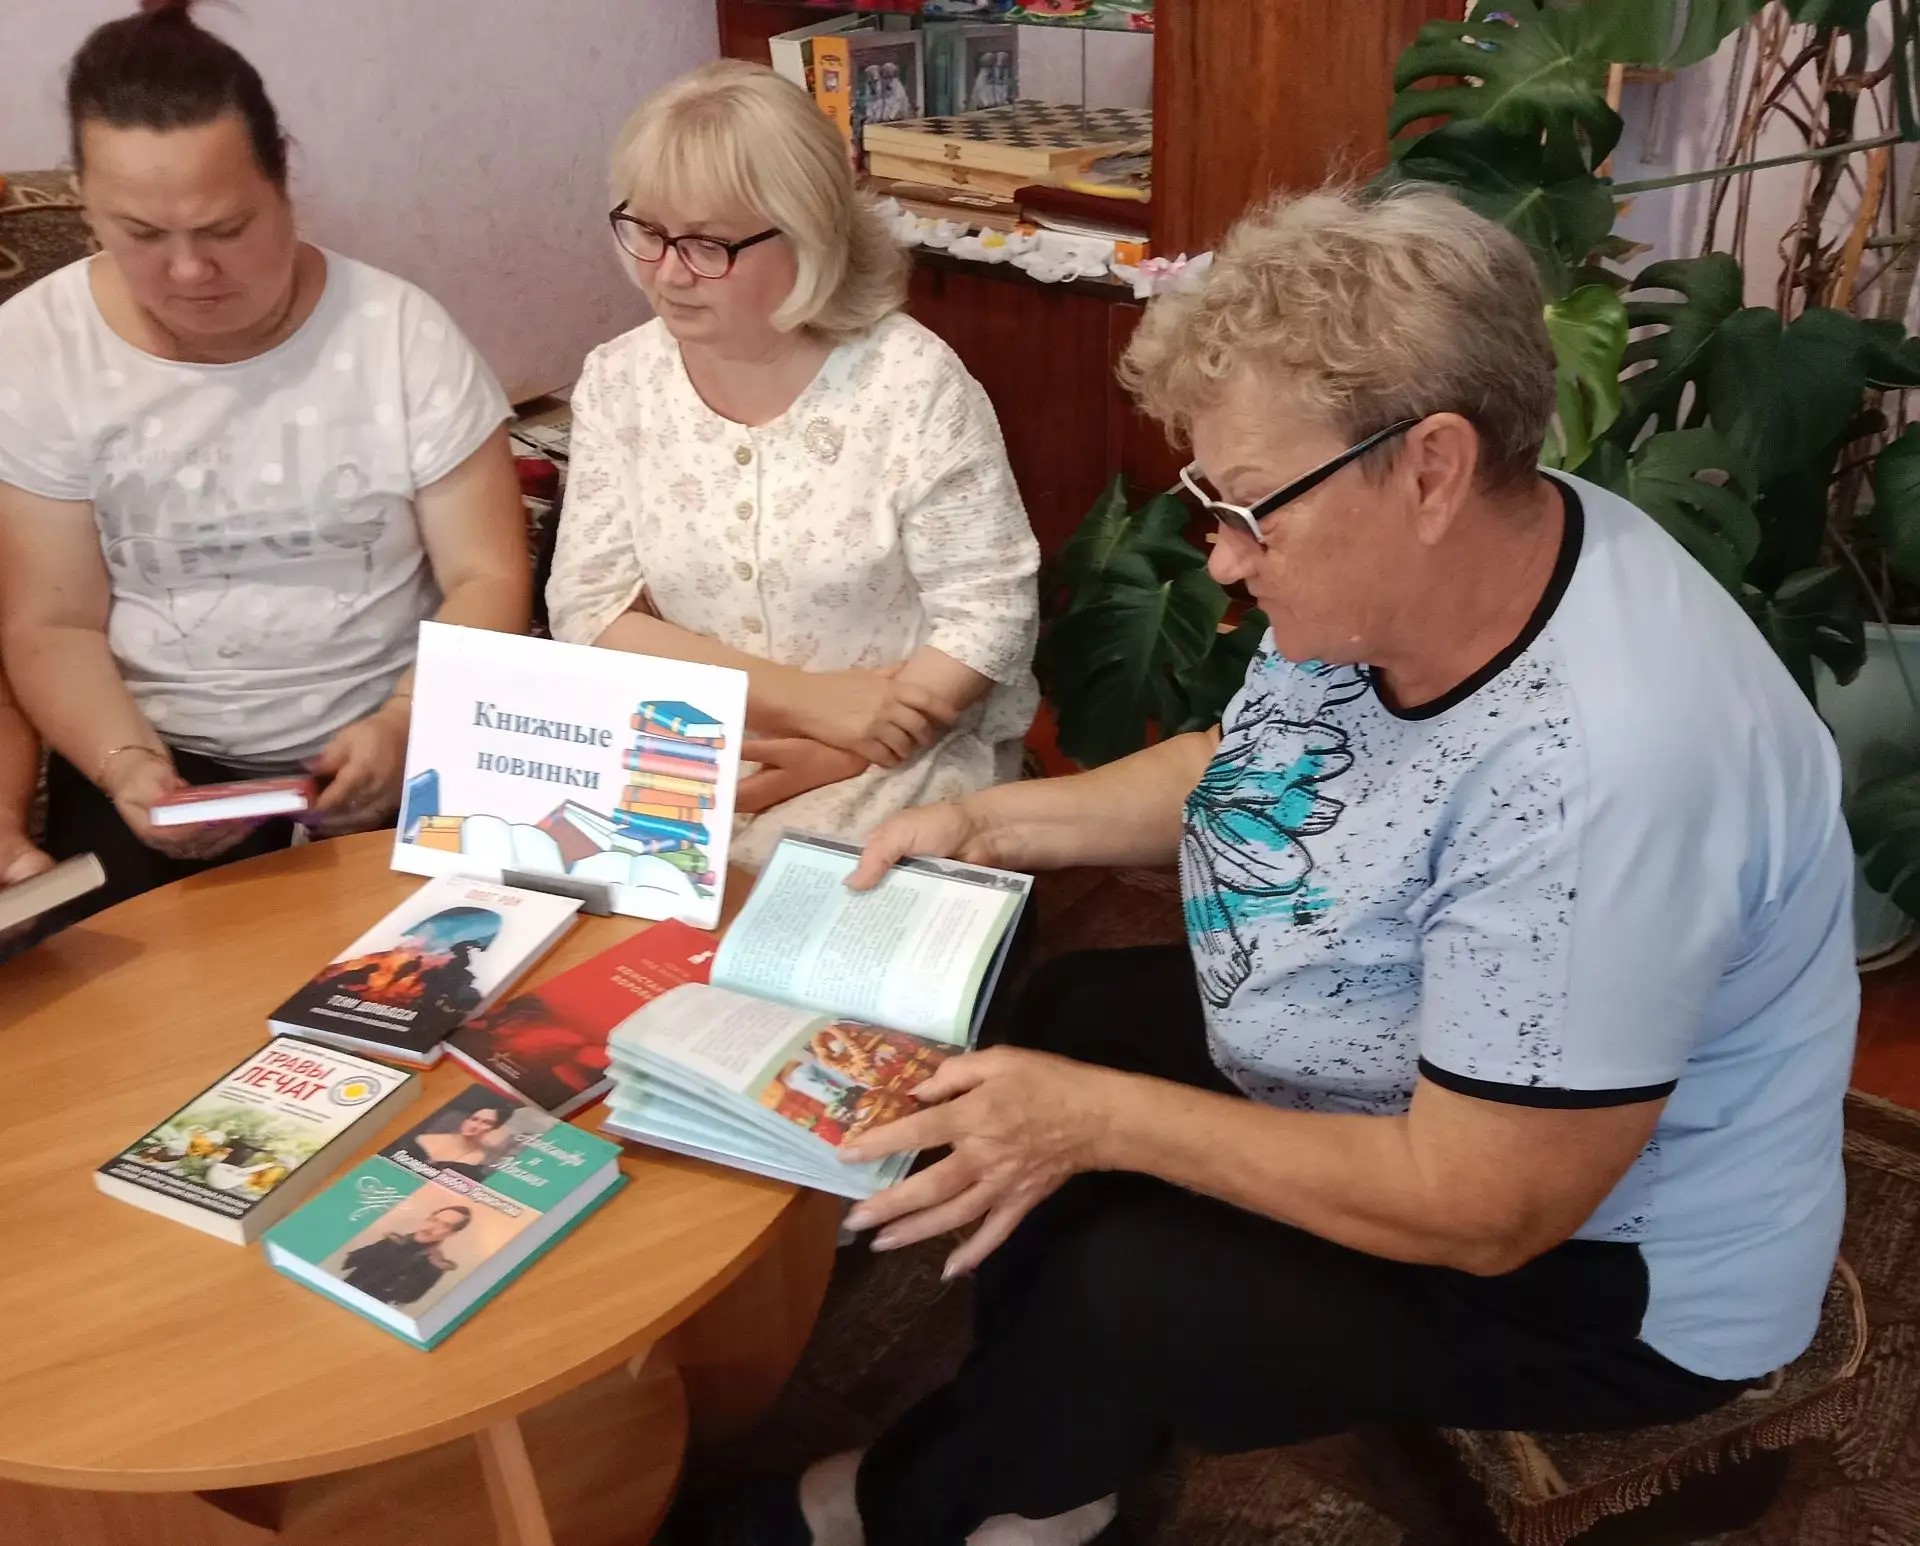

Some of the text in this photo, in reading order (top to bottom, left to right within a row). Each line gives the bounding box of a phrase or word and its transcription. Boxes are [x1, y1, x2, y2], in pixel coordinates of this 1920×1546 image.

[472, 701, 613, 747] Книжные
[476, 751, 600, 790] новинки
[232, 1066, 330, 1101] ЛЕЧАТ
[259, 1050, 336, 1080] ТРАВЫ
